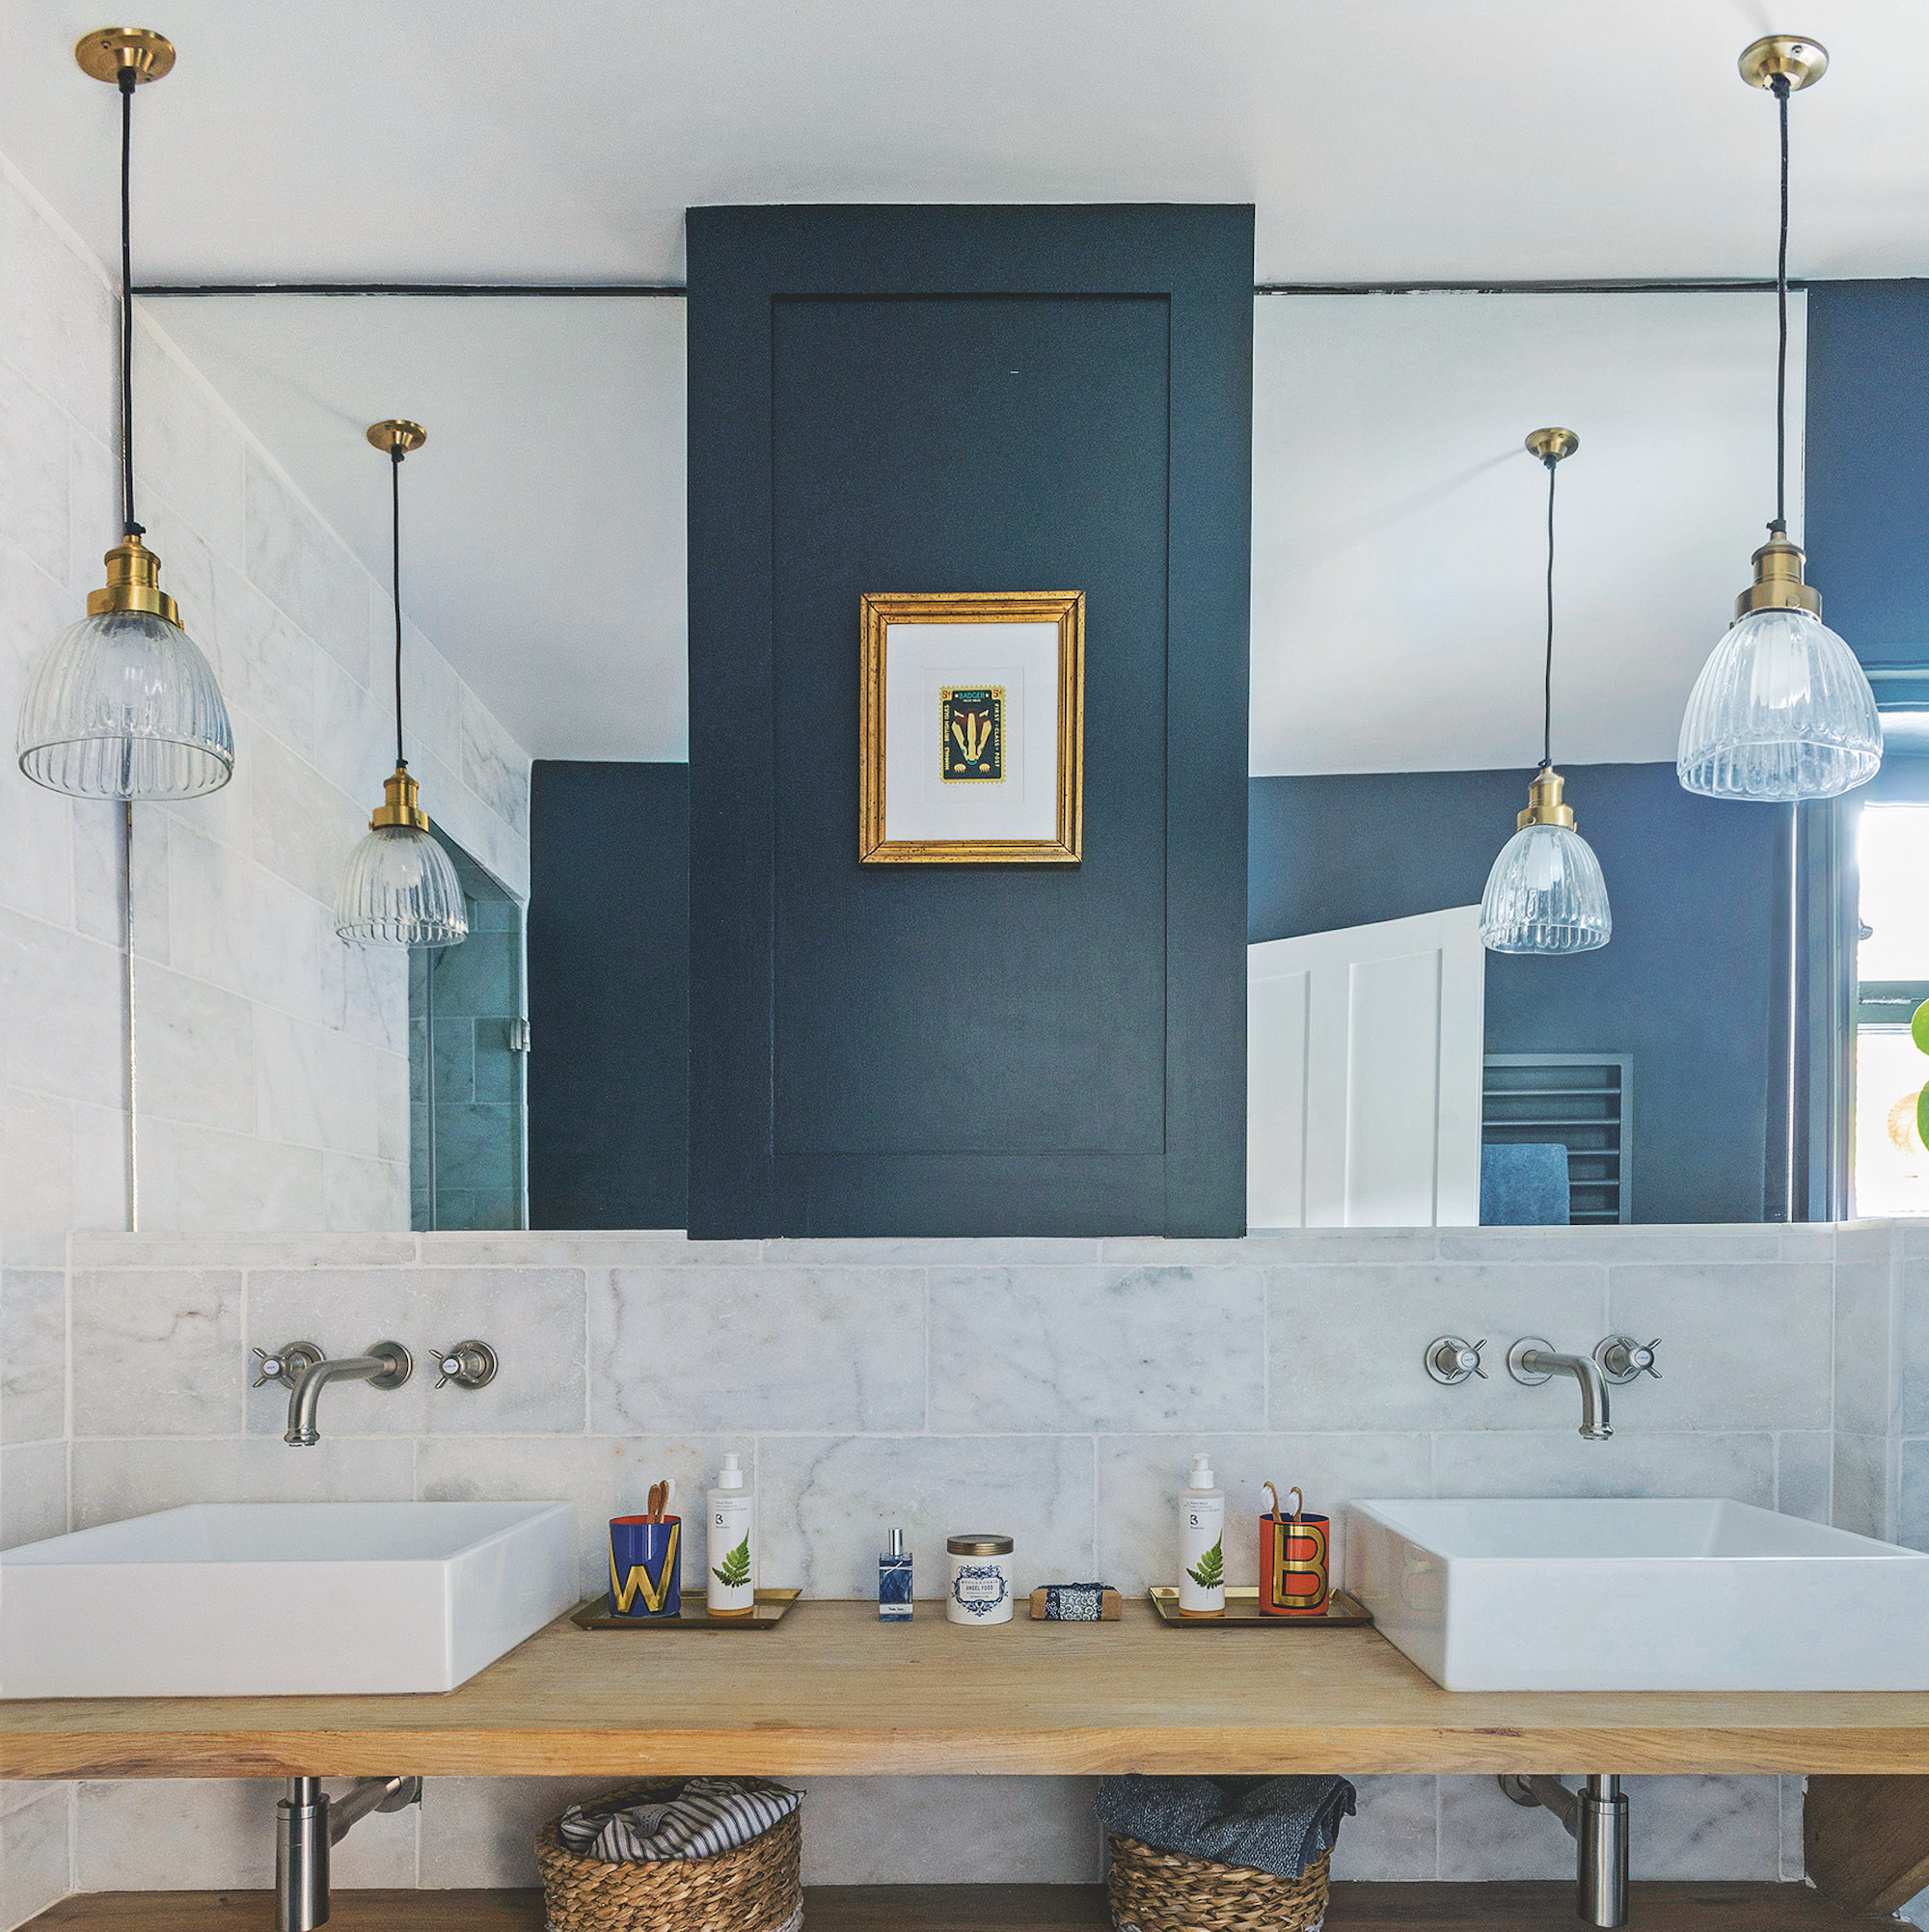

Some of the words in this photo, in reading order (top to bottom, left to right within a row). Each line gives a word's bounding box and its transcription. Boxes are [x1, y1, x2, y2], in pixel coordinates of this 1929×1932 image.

[959, 691, 986, 699] BADGER
[609, 1523, 681, 1614] W
[1272, 1522, 1328, 1610] B
